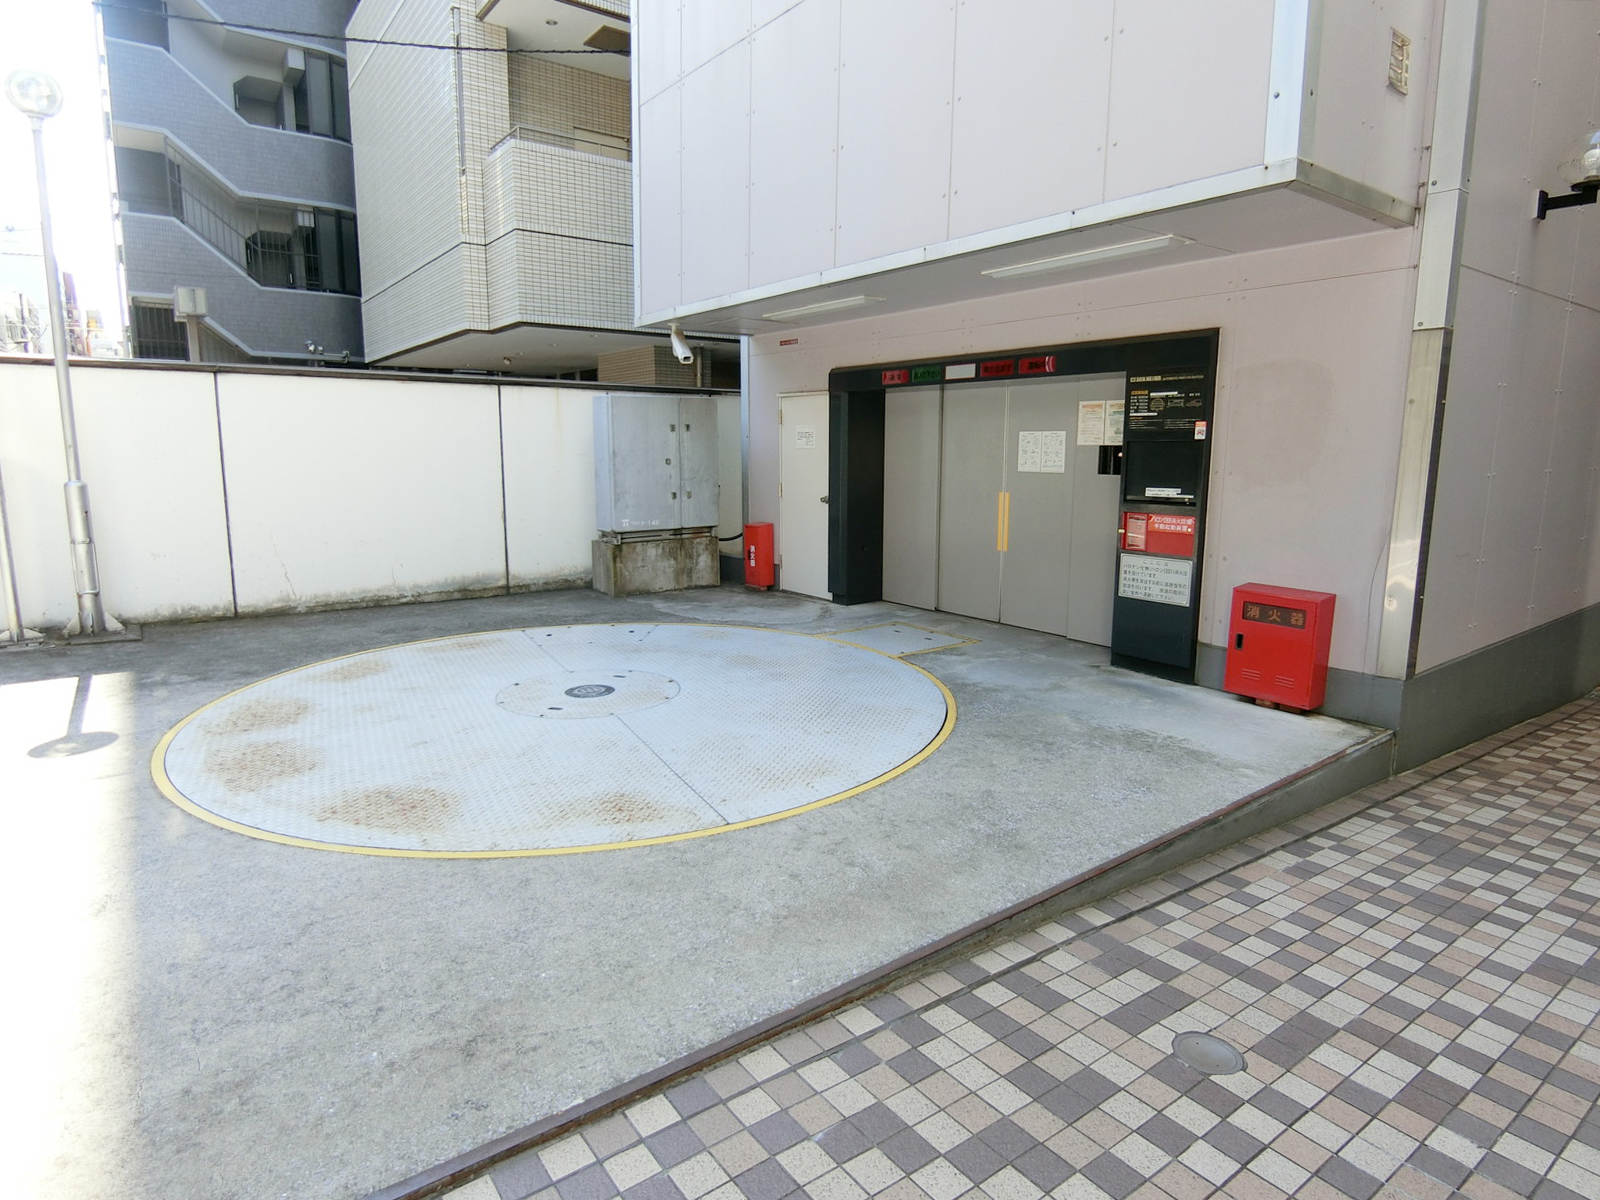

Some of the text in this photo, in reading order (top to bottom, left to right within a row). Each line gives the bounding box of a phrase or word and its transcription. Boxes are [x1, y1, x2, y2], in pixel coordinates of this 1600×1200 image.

[1154, 523, 1188, 532] 手動起動装置
[1246, 605, 1304, 626] 消火器
